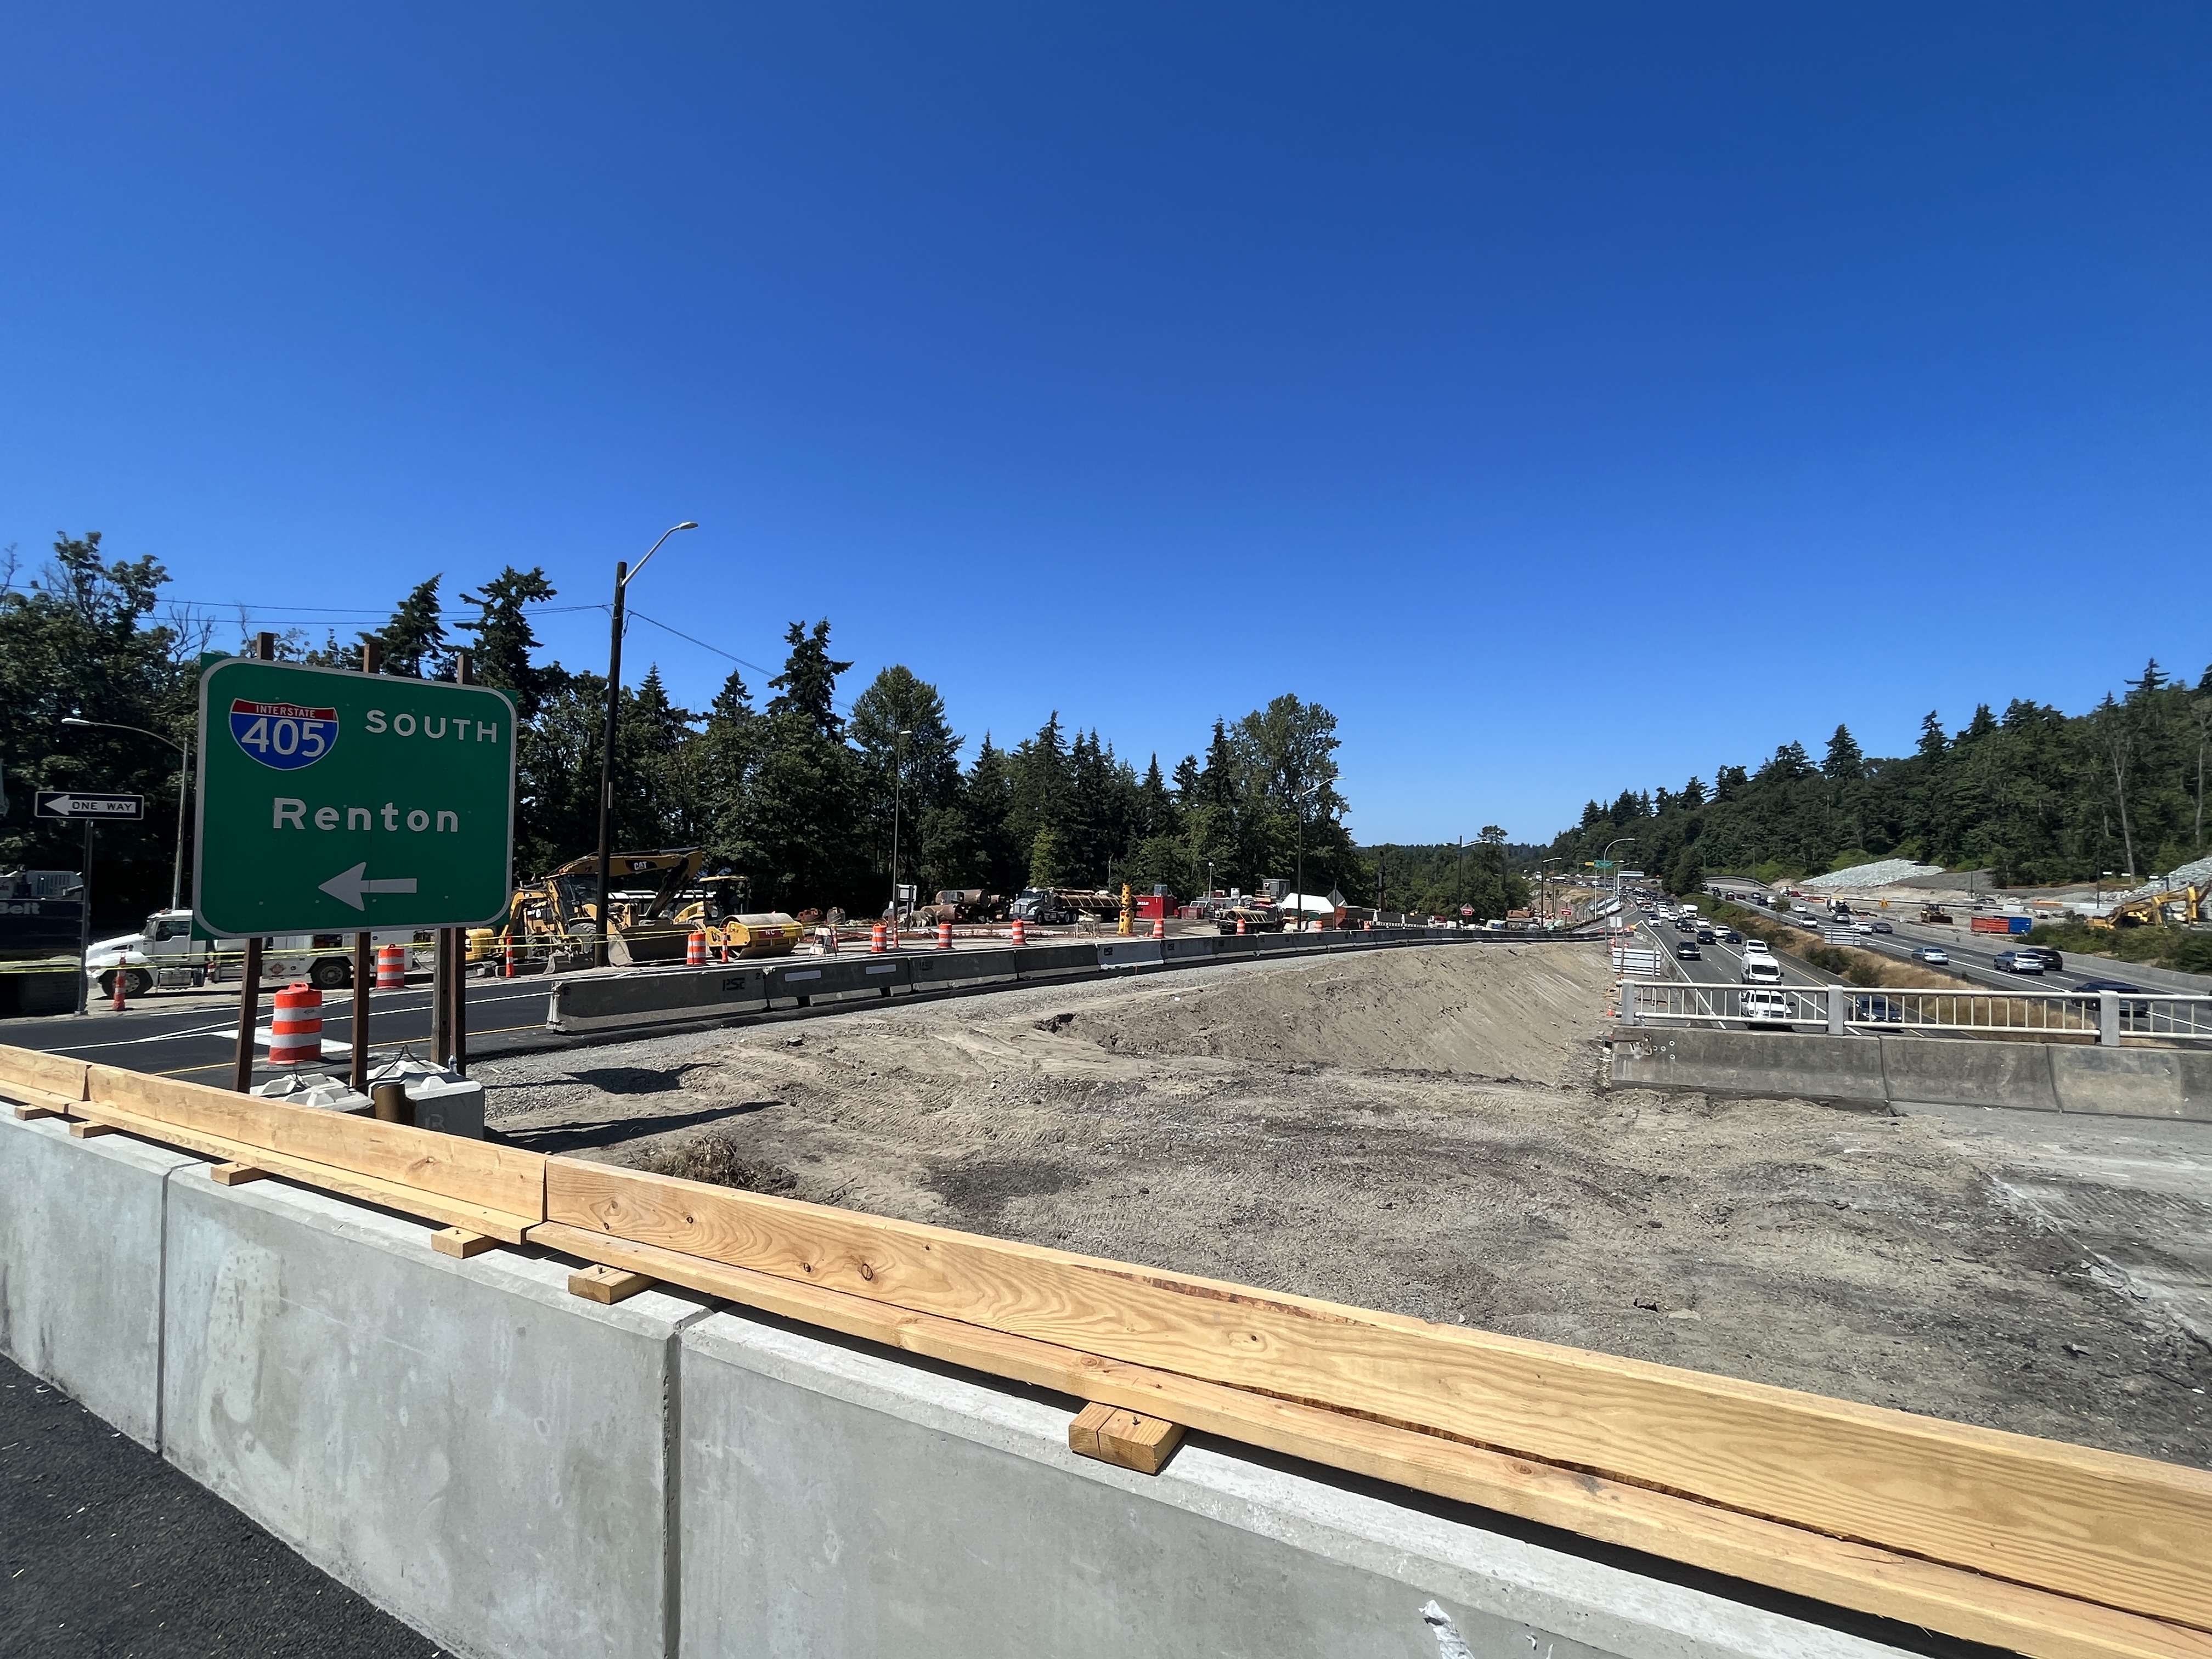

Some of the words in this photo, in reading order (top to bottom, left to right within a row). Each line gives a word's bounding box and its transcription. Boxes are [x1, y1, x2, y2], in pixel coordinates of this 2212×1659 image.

[256, 704, 316, 718] INTERSTATE
[241, 717, 325, 757] 405
[364, 709, 497, 743] SOUTH
[72, 801, 98, 810] ONE
[106, 802, 132, 811] WAY
[273, 797, 459, 833] Renton
[634, 861, 647, 871] CAT
